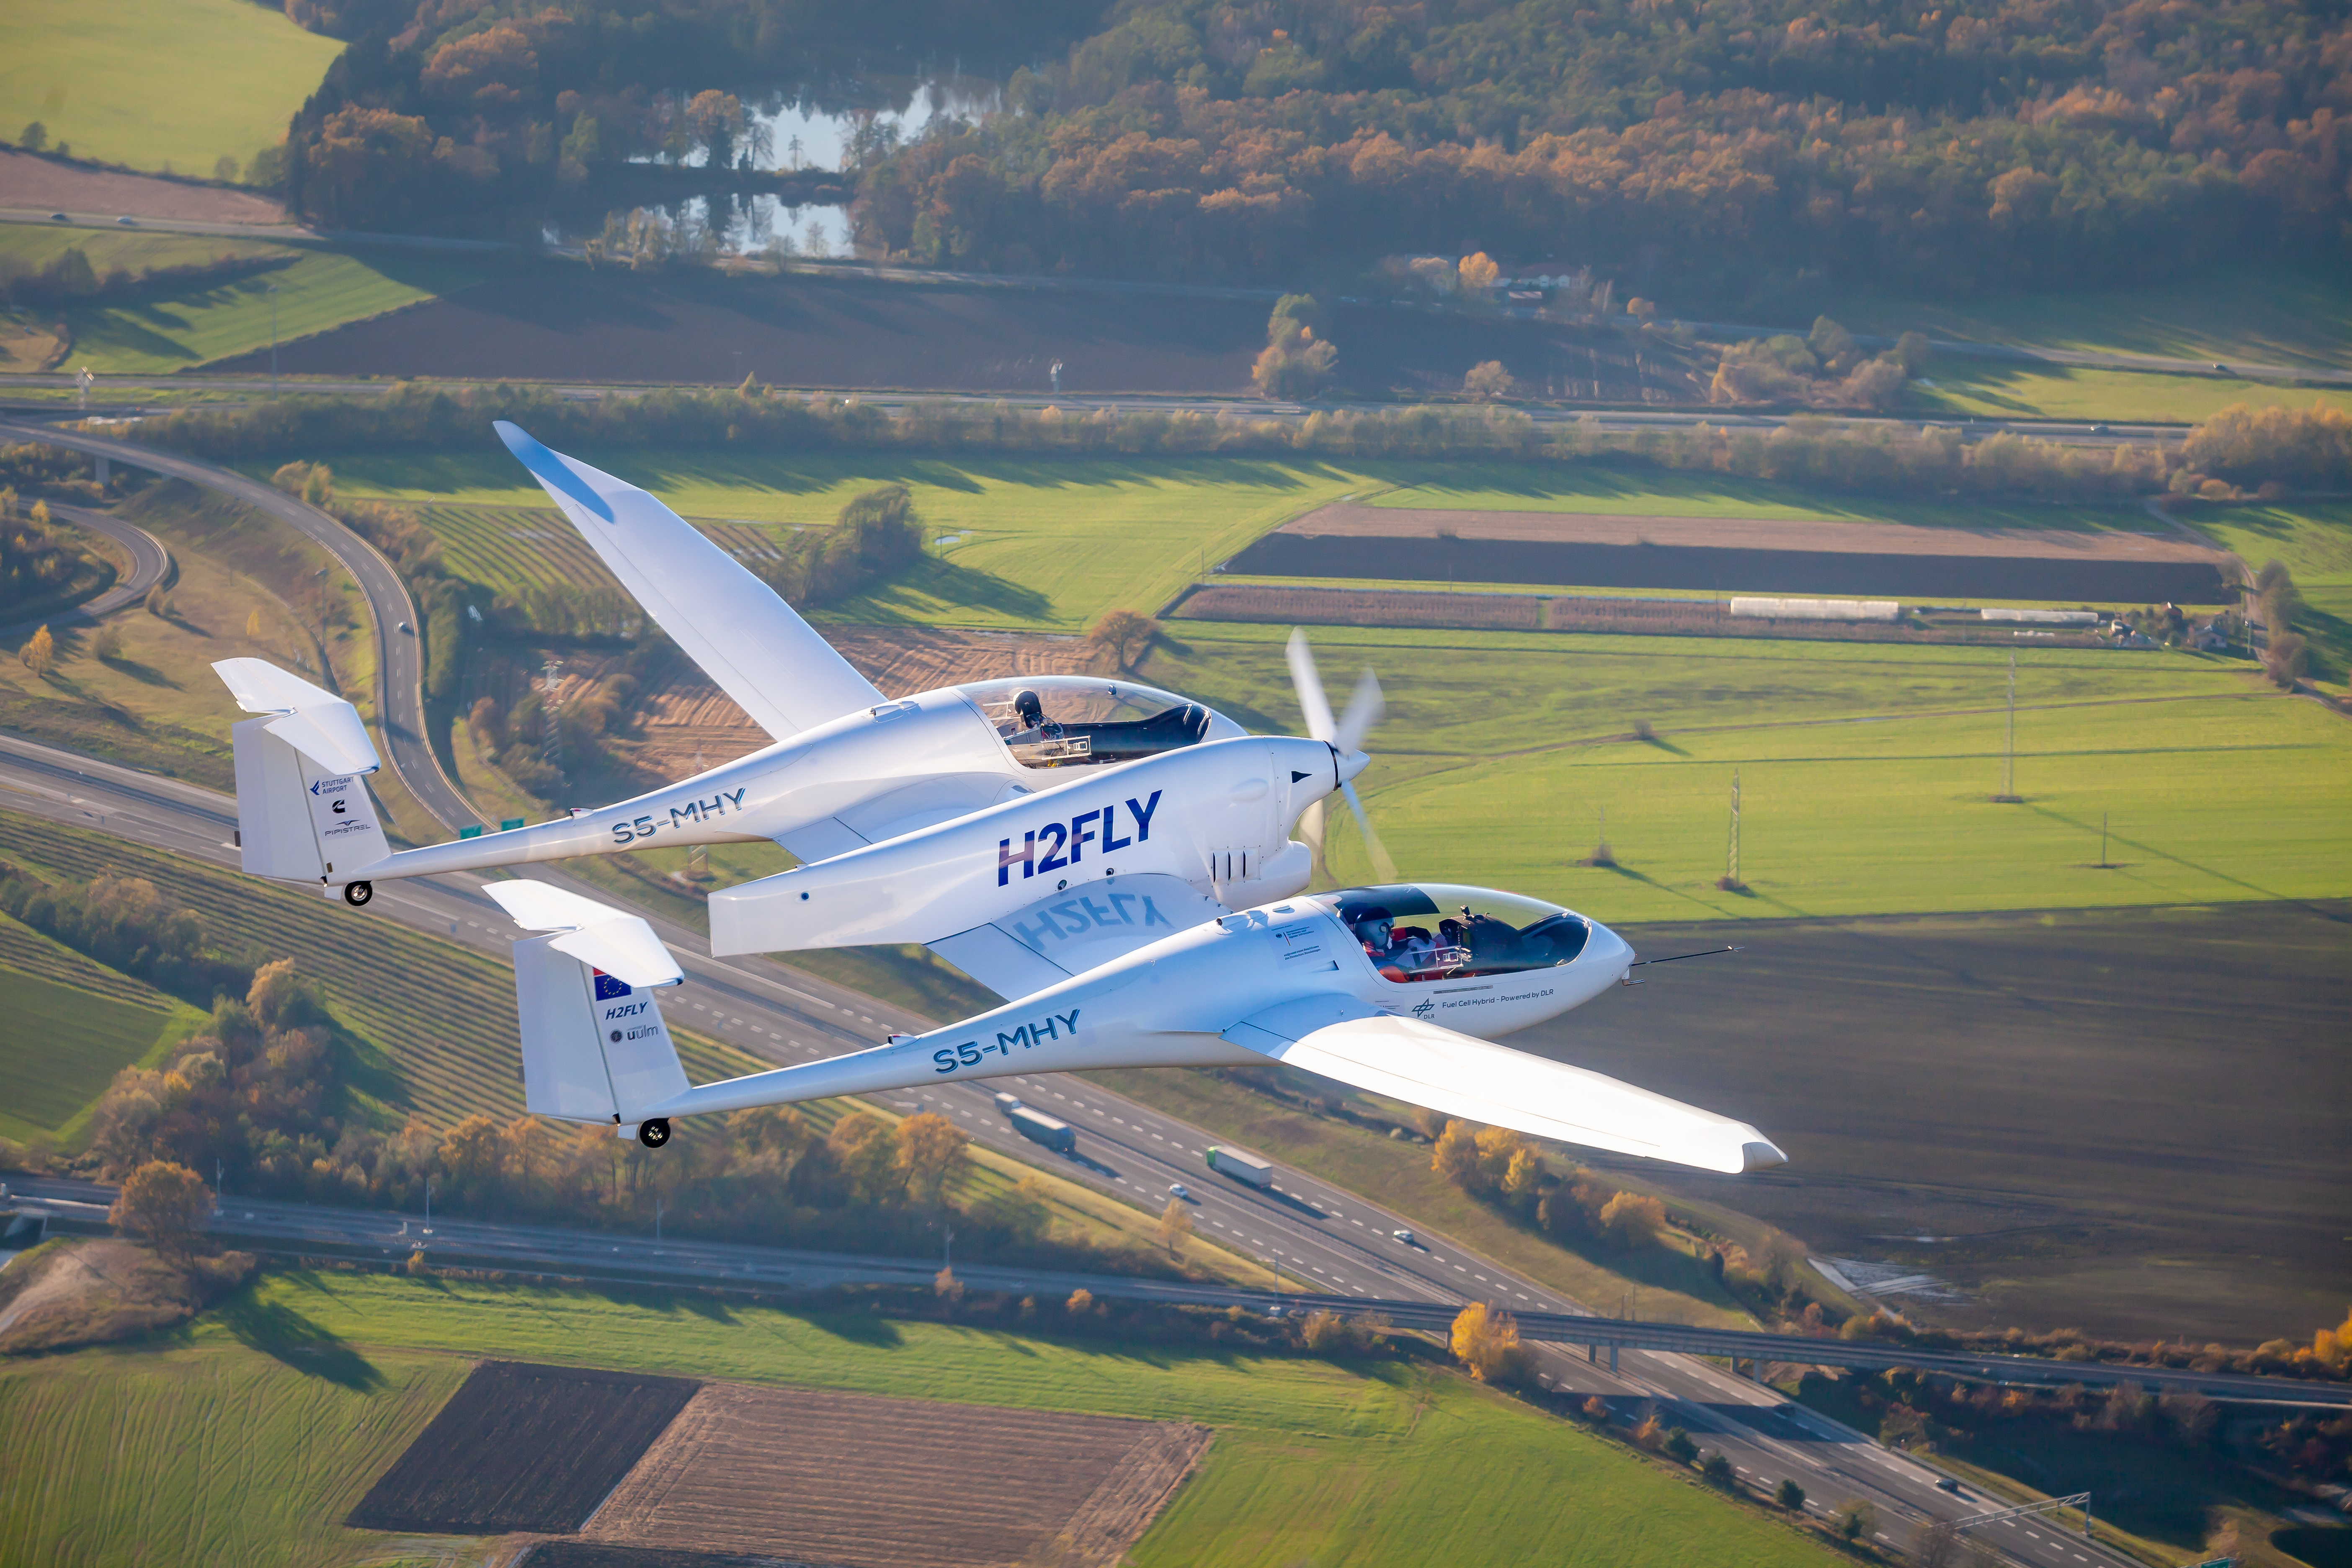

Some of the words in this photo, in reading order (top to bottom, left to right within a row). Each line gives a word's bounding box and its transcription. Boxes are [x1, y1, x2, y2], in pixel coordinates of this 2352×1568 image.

[322, 776, 354, 788] STUTTGART
[322, 785, 347, 794] AIRPORT
[612, 787, 745, 844] S5-MHY
[325, 824, 371, 836] PIPISTREL
[998, 789, 1163, 887] H2FLY
[1472, 997, 1495, 1008] Hybrid
[1501, 992, 1531, 1002] Powered
[605, 1001, 648, 1021] H2FLY
[933, 1008, 1080, 1073] S5-MHY
